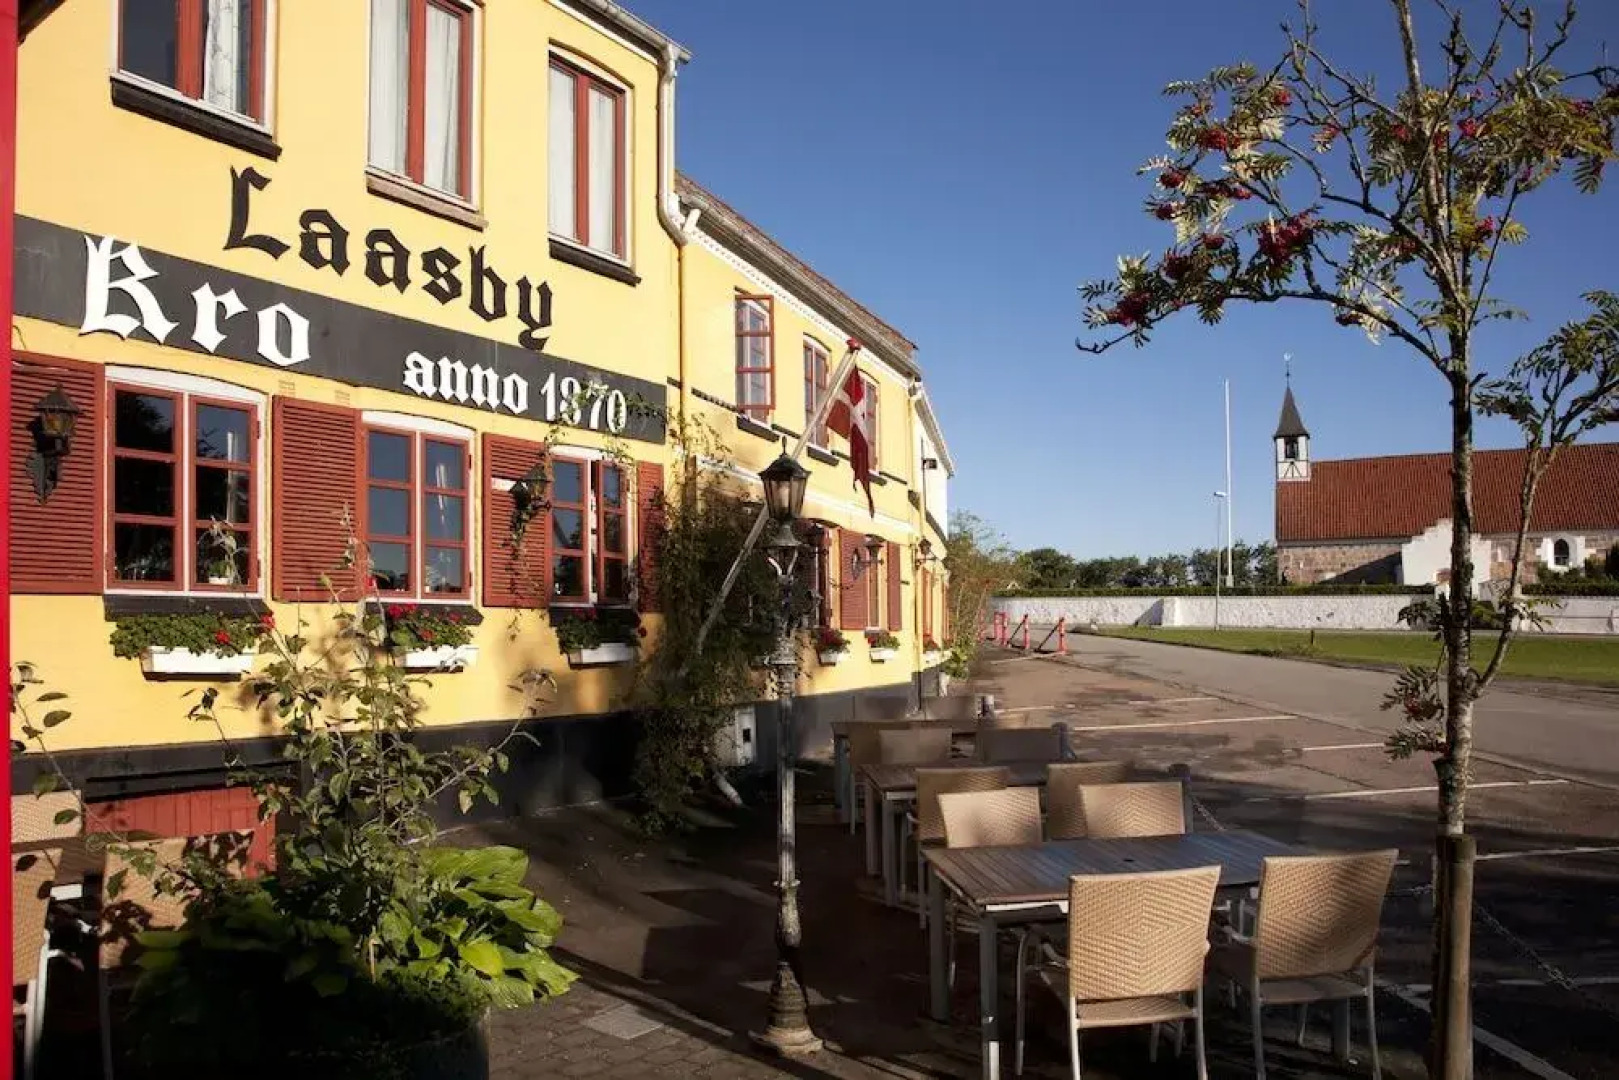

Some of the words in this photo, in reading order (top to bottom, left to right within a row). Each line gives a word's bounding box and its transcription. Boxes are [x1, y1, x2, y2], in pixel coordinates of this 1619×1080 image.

[80, 235, 311, 366] Kro
[224, 166, 553, 349] Laasby
[403, 350, 528, 414] anno
[541, 372, 627, 433] 1870
